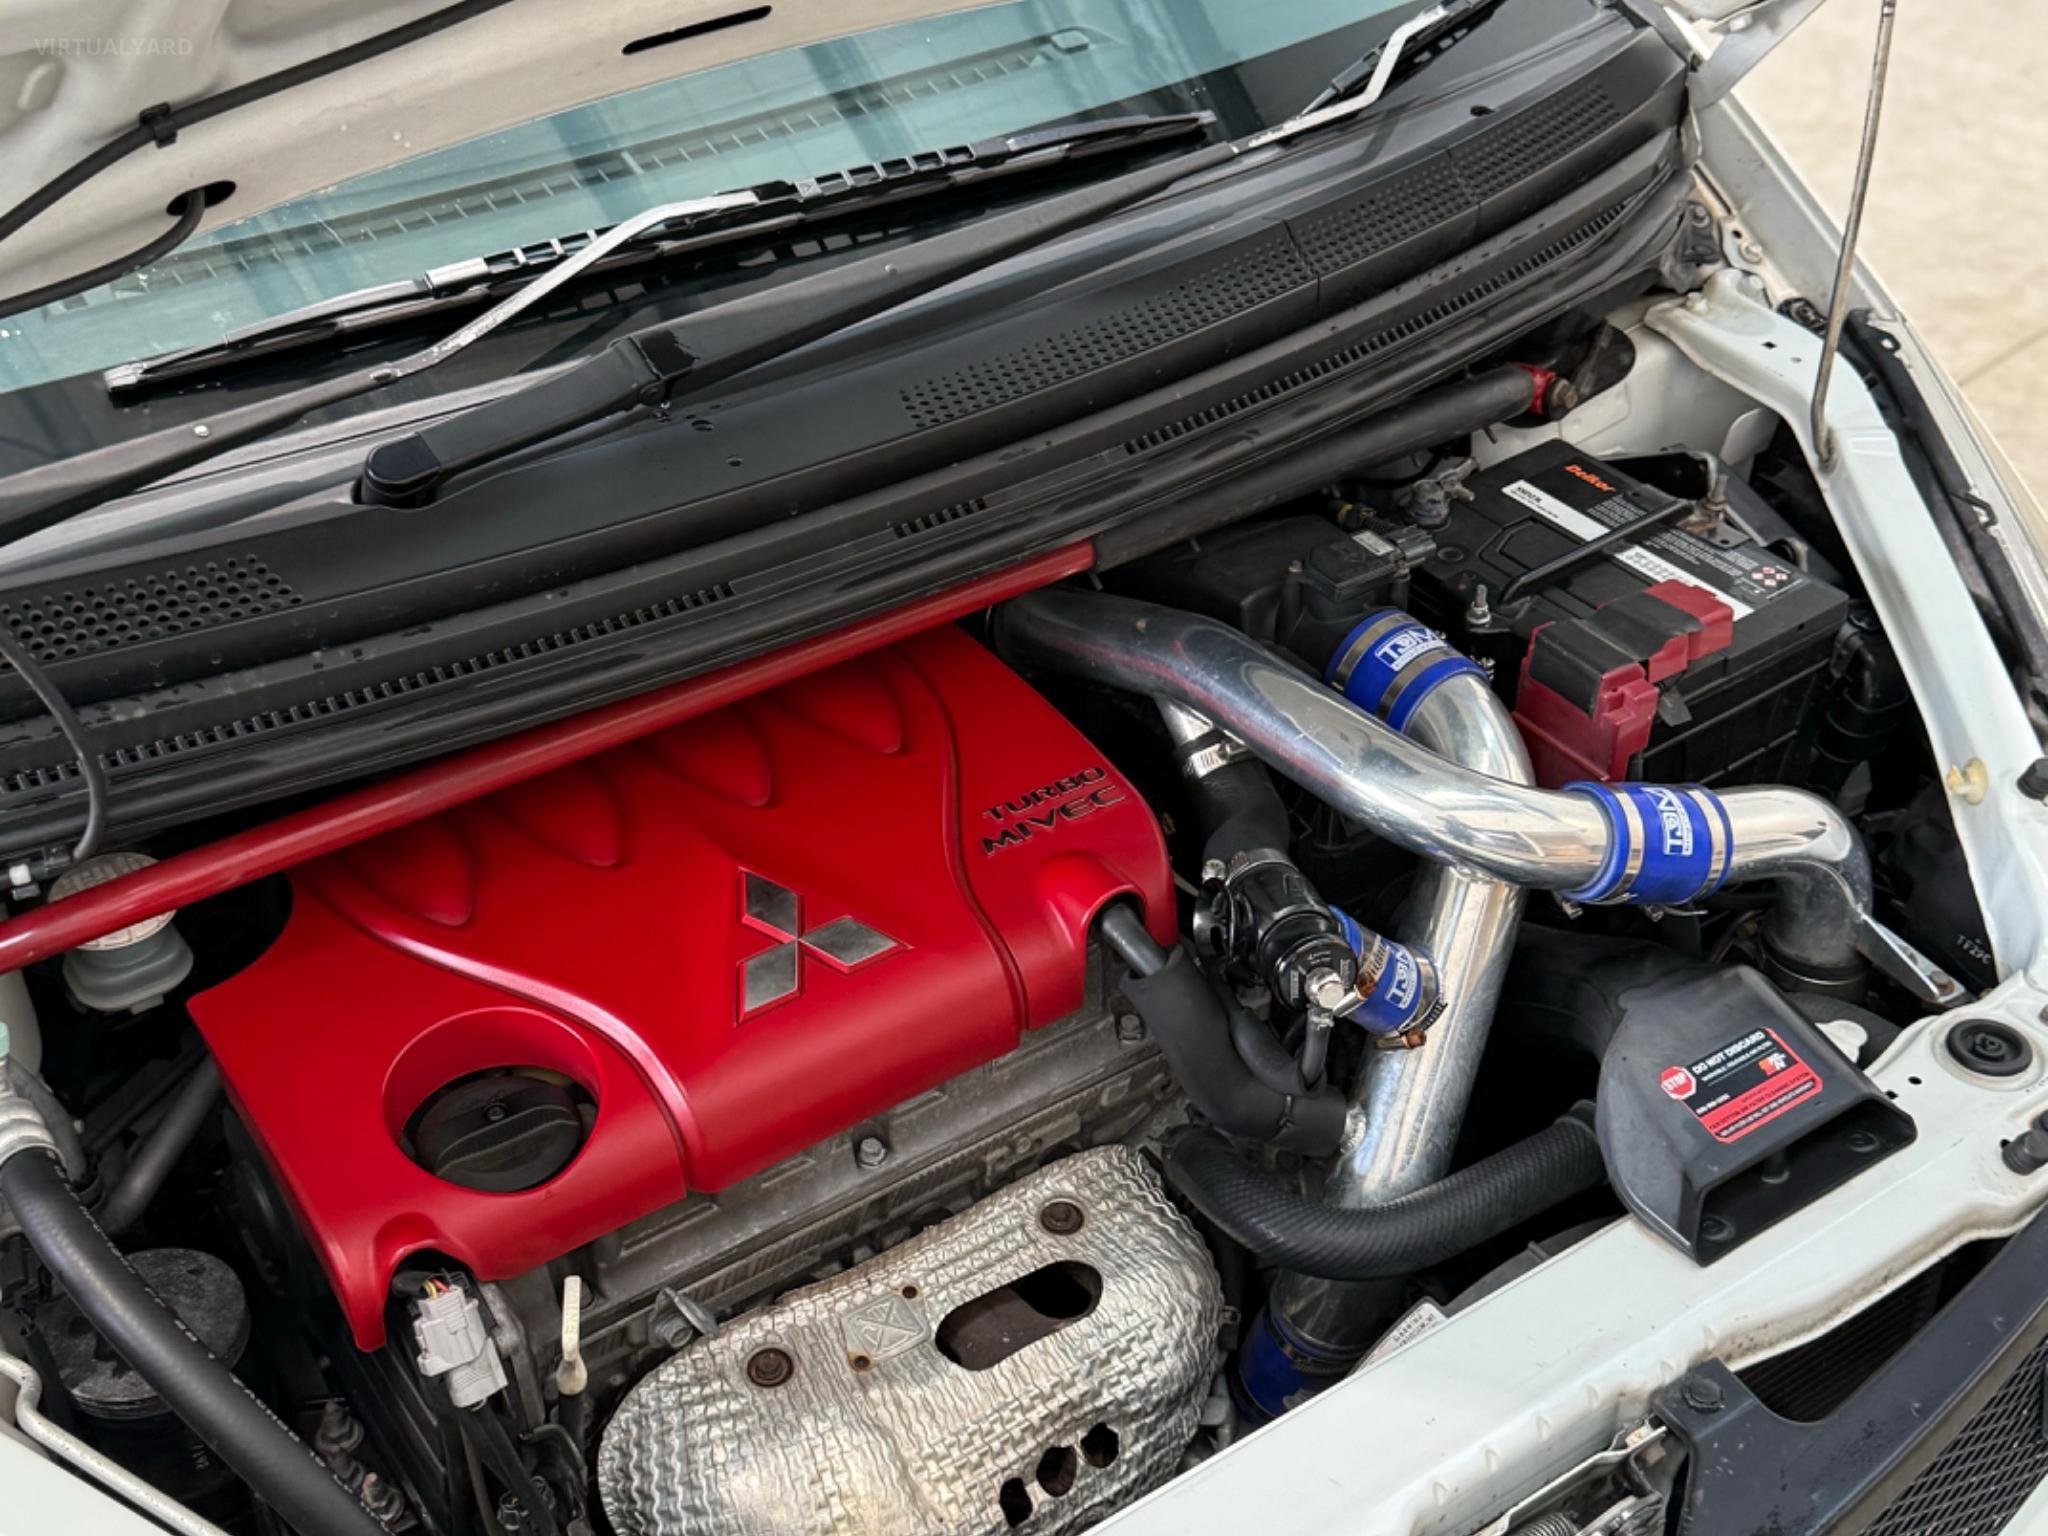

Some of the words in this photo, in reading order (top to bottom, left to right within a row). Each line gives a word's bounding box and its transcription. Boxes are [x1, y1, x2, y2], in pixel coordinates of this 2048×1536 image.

[982, 783, 1126, 857] MIVEC
[983, 766, 1106, 821] TURBO
[1663, 1071, 1690, 1093] STOP
